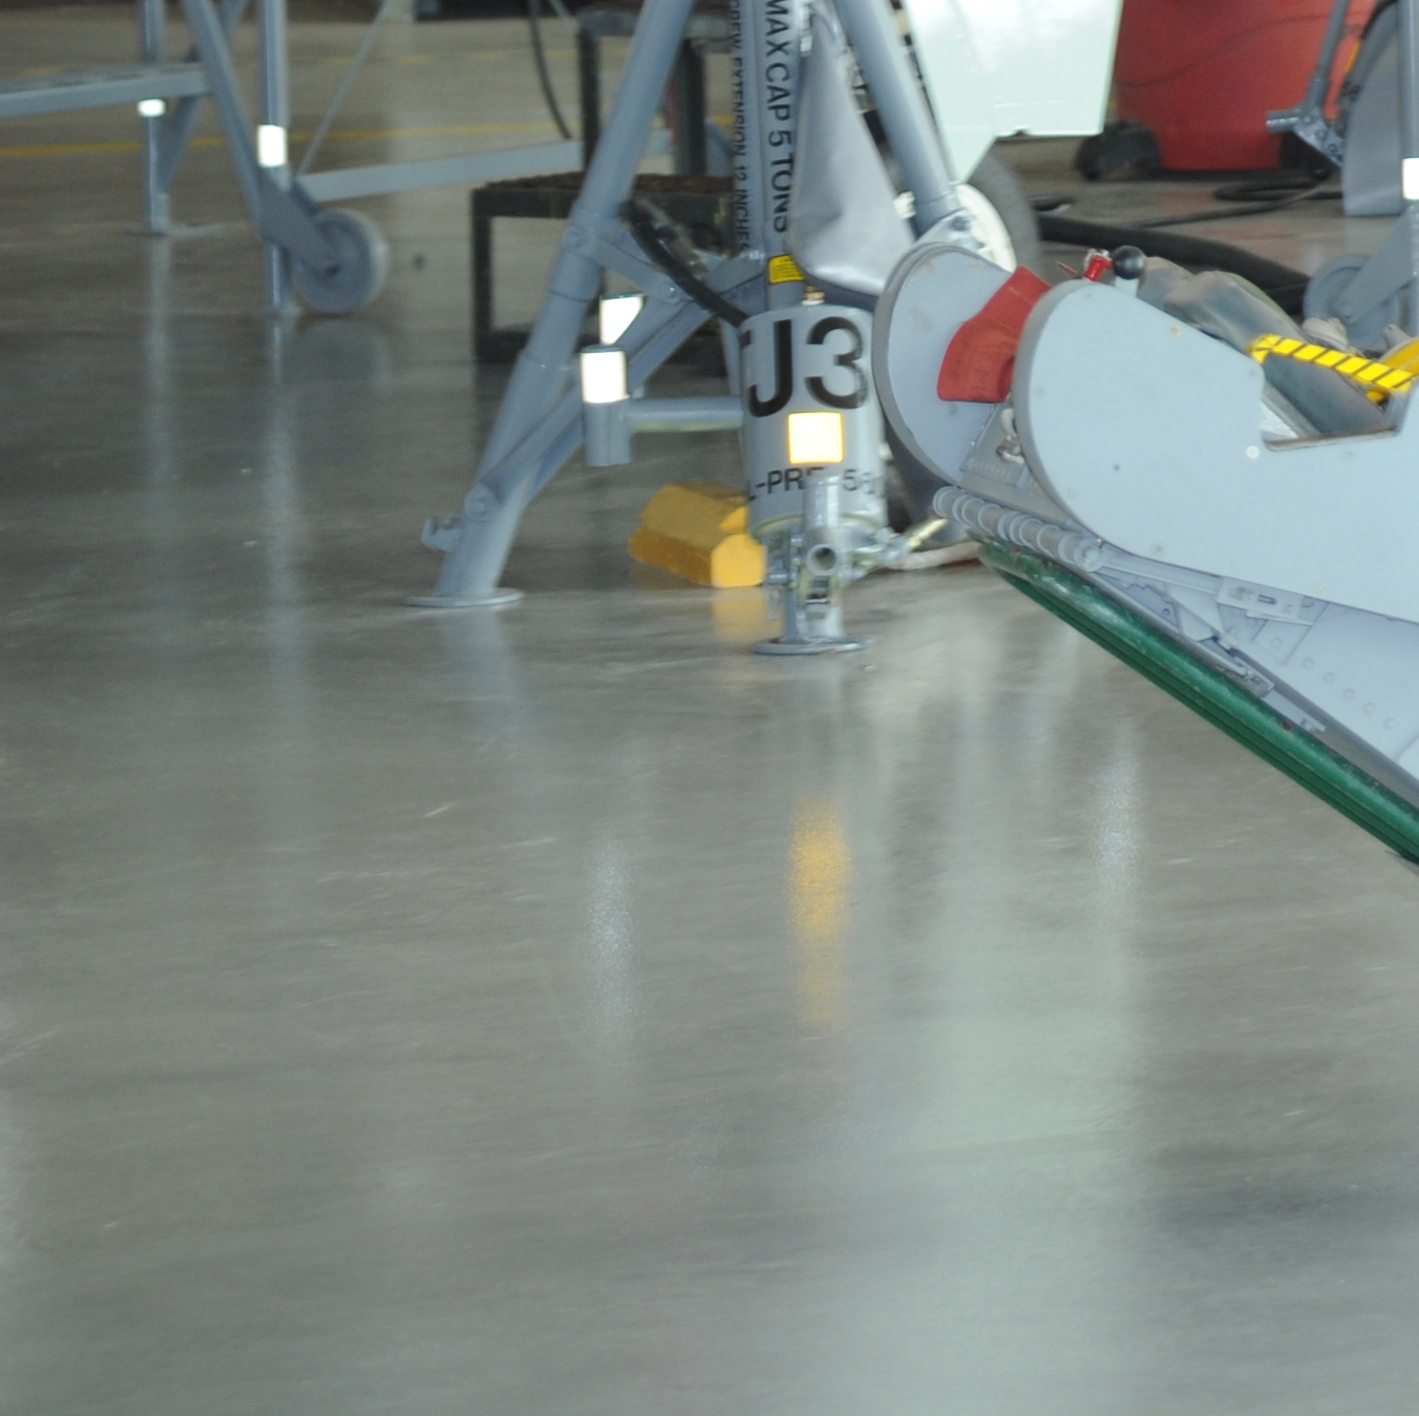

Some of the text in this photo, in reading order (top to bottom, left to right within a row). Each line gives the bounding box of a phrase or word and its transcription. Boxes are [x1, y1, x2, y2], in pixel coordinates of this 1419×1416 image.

[765, 62, 791, 122] CAP
[767, 130, 793, 147] 5
[771, 152, 795, 233] TONS
